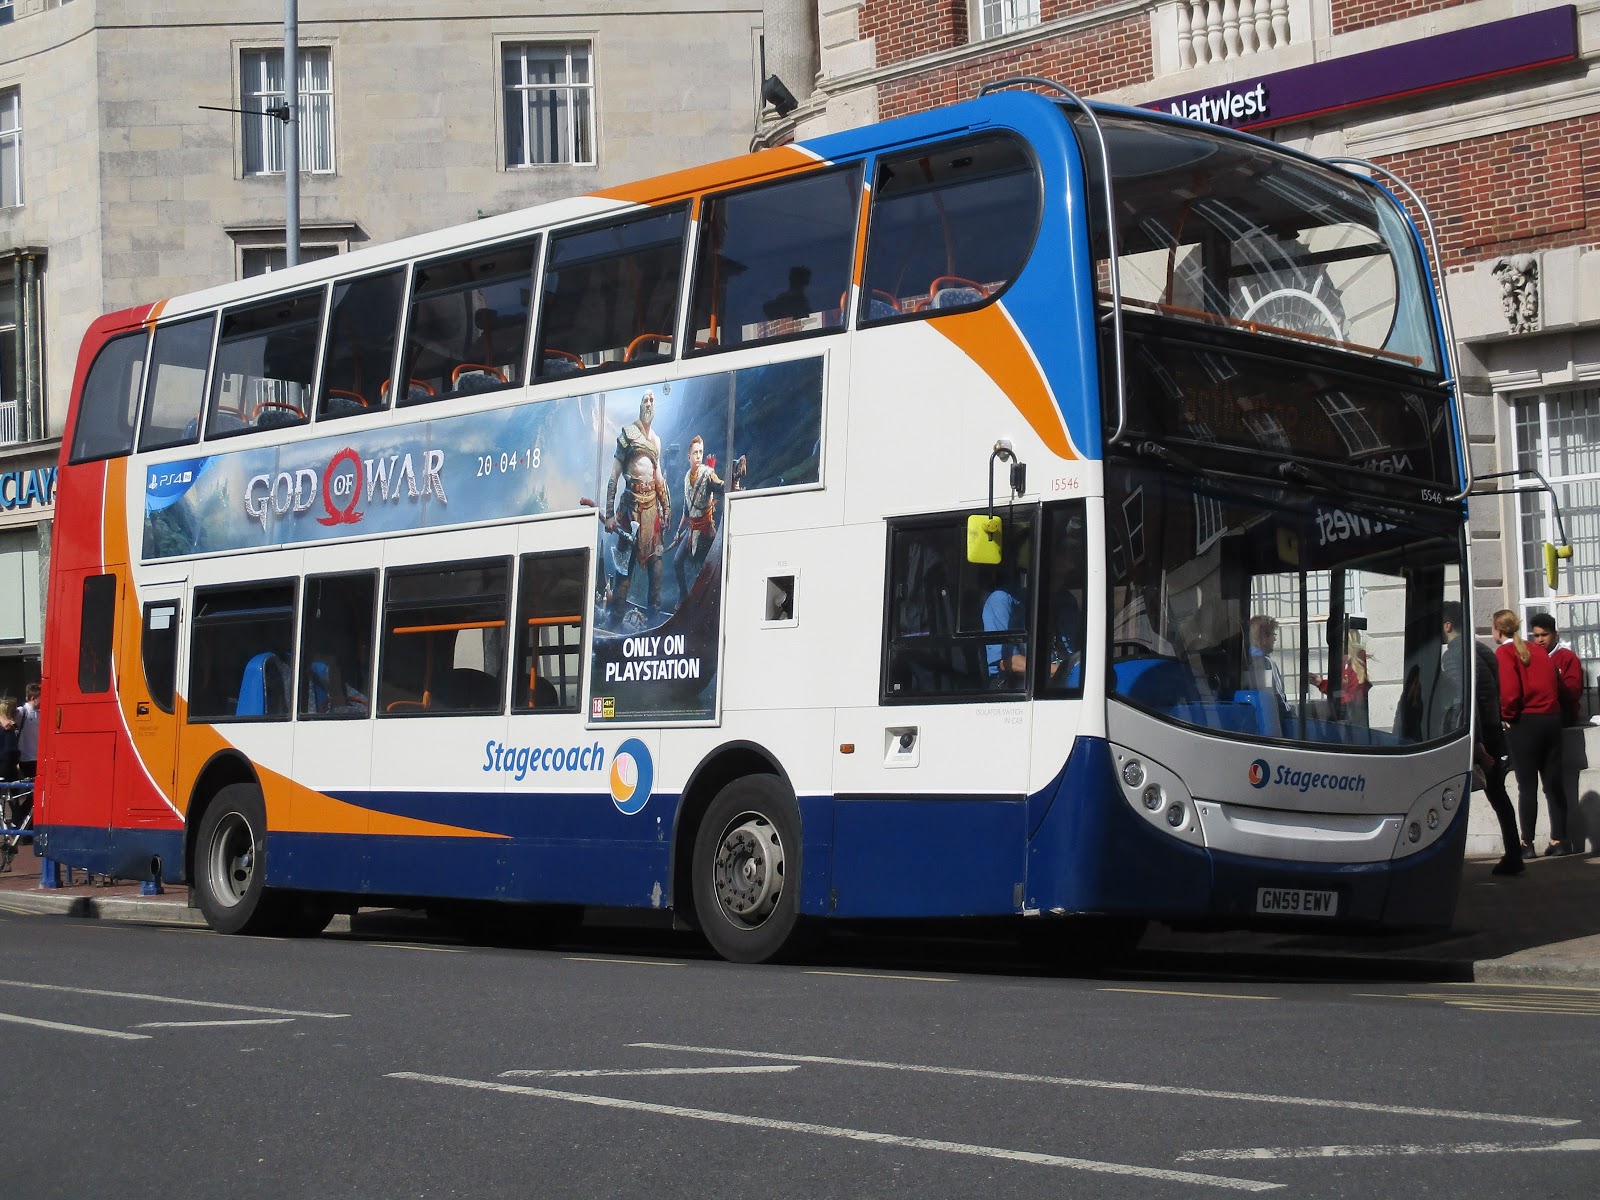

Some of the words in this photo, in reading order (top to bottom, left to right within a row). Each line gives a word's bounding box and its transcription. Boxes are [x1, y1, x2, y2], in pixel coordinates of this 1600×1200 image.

[1170, 82, 1266, 124] NatWest
[159, 473, 182, 487] PS4
[244, 468, 318, 532] GOD
[333, 473, 354, 495] OF
[364, 449, 448, 504] WAR
[1051, 477, 1079, 491] 15546
[1421, 489, 1442, 504] 15546
[622, 636, 661, 658] ONLY
[664, 634, 685, 656] ON
[605, 657, 700, 682] PLAYSTATION
[593, 699, 602, 713] 18
[1002, 708, 1024, 716] SWITCH
[1011, 717, 1023, 725] CAB
[482, 740, 605, 781] Stagecoach
[1274, 764, 1366, 793] Stagecoach
[1262, 890, 1300, 910] GN59
[1303, 892, 1332, 911] EWV
